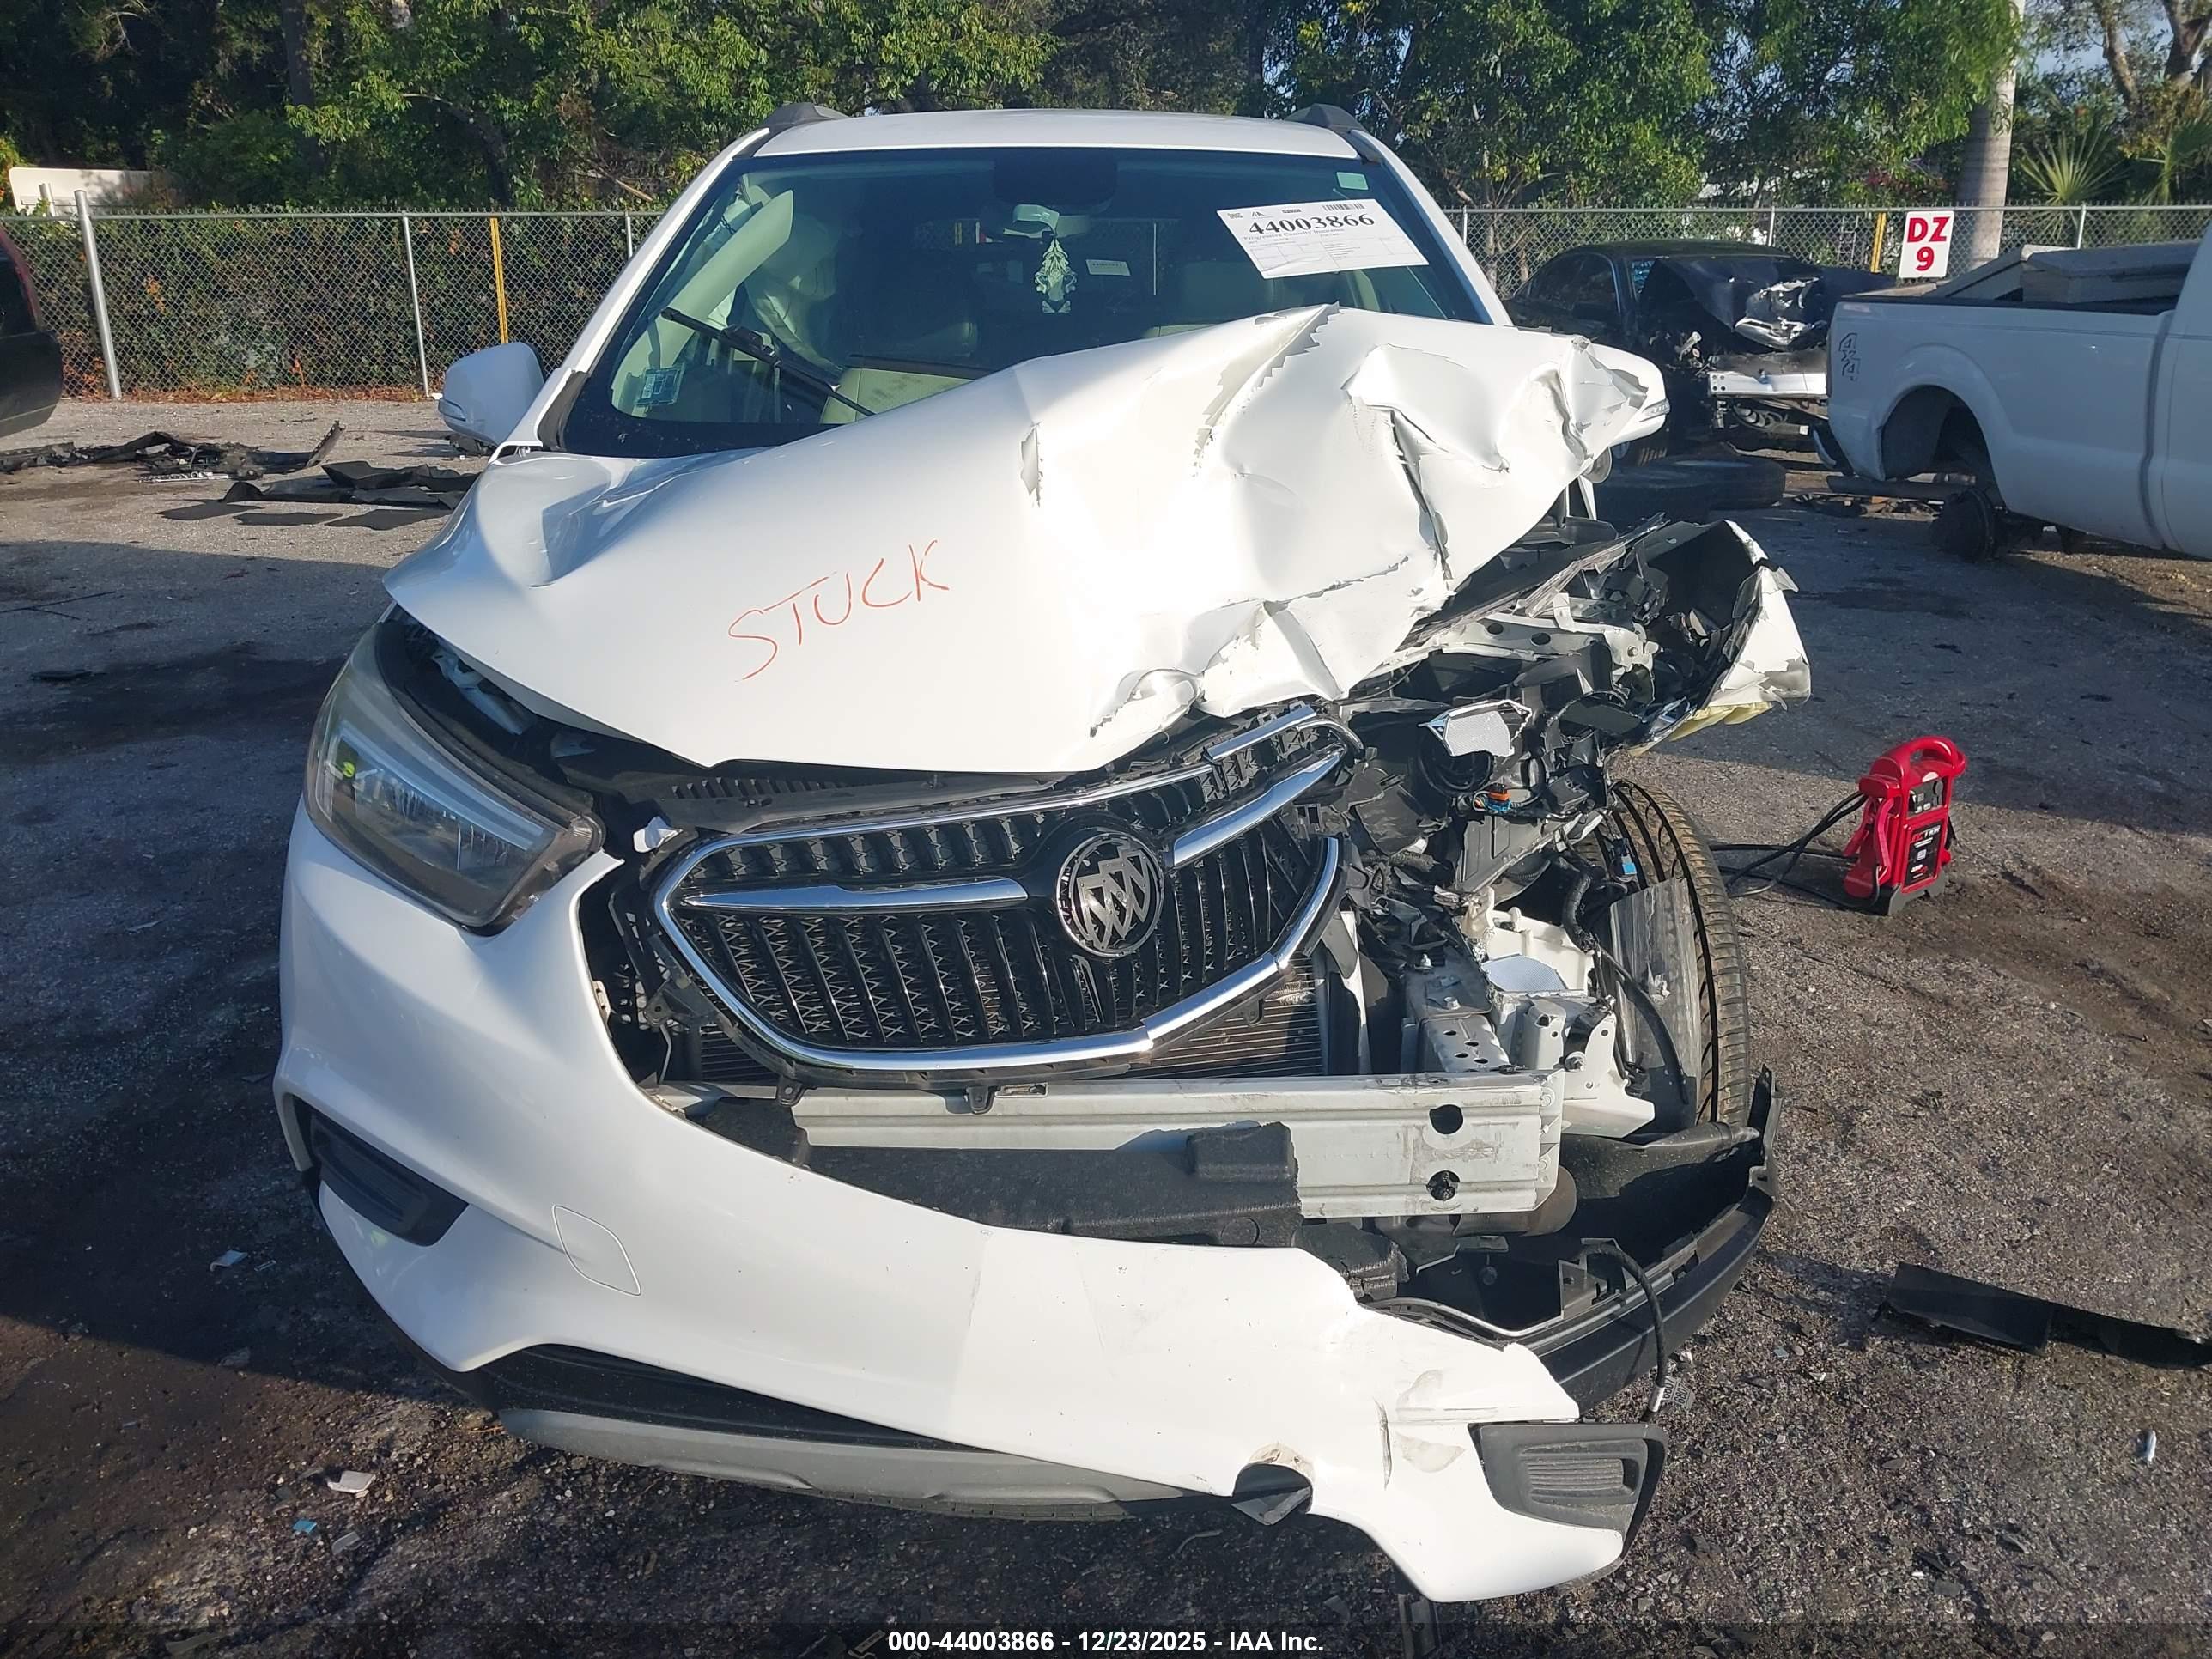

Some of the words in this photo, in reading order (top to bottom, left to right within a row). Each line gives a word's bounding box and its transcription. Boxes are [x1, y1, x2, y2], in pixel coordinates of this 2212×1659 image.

[1249, 213, 1375, 234] 44003866
[1906, 216, 1951, 243] DZ
[1915, 246, 1935, 271] 9
[728, 539, 950, 682] STUCK
